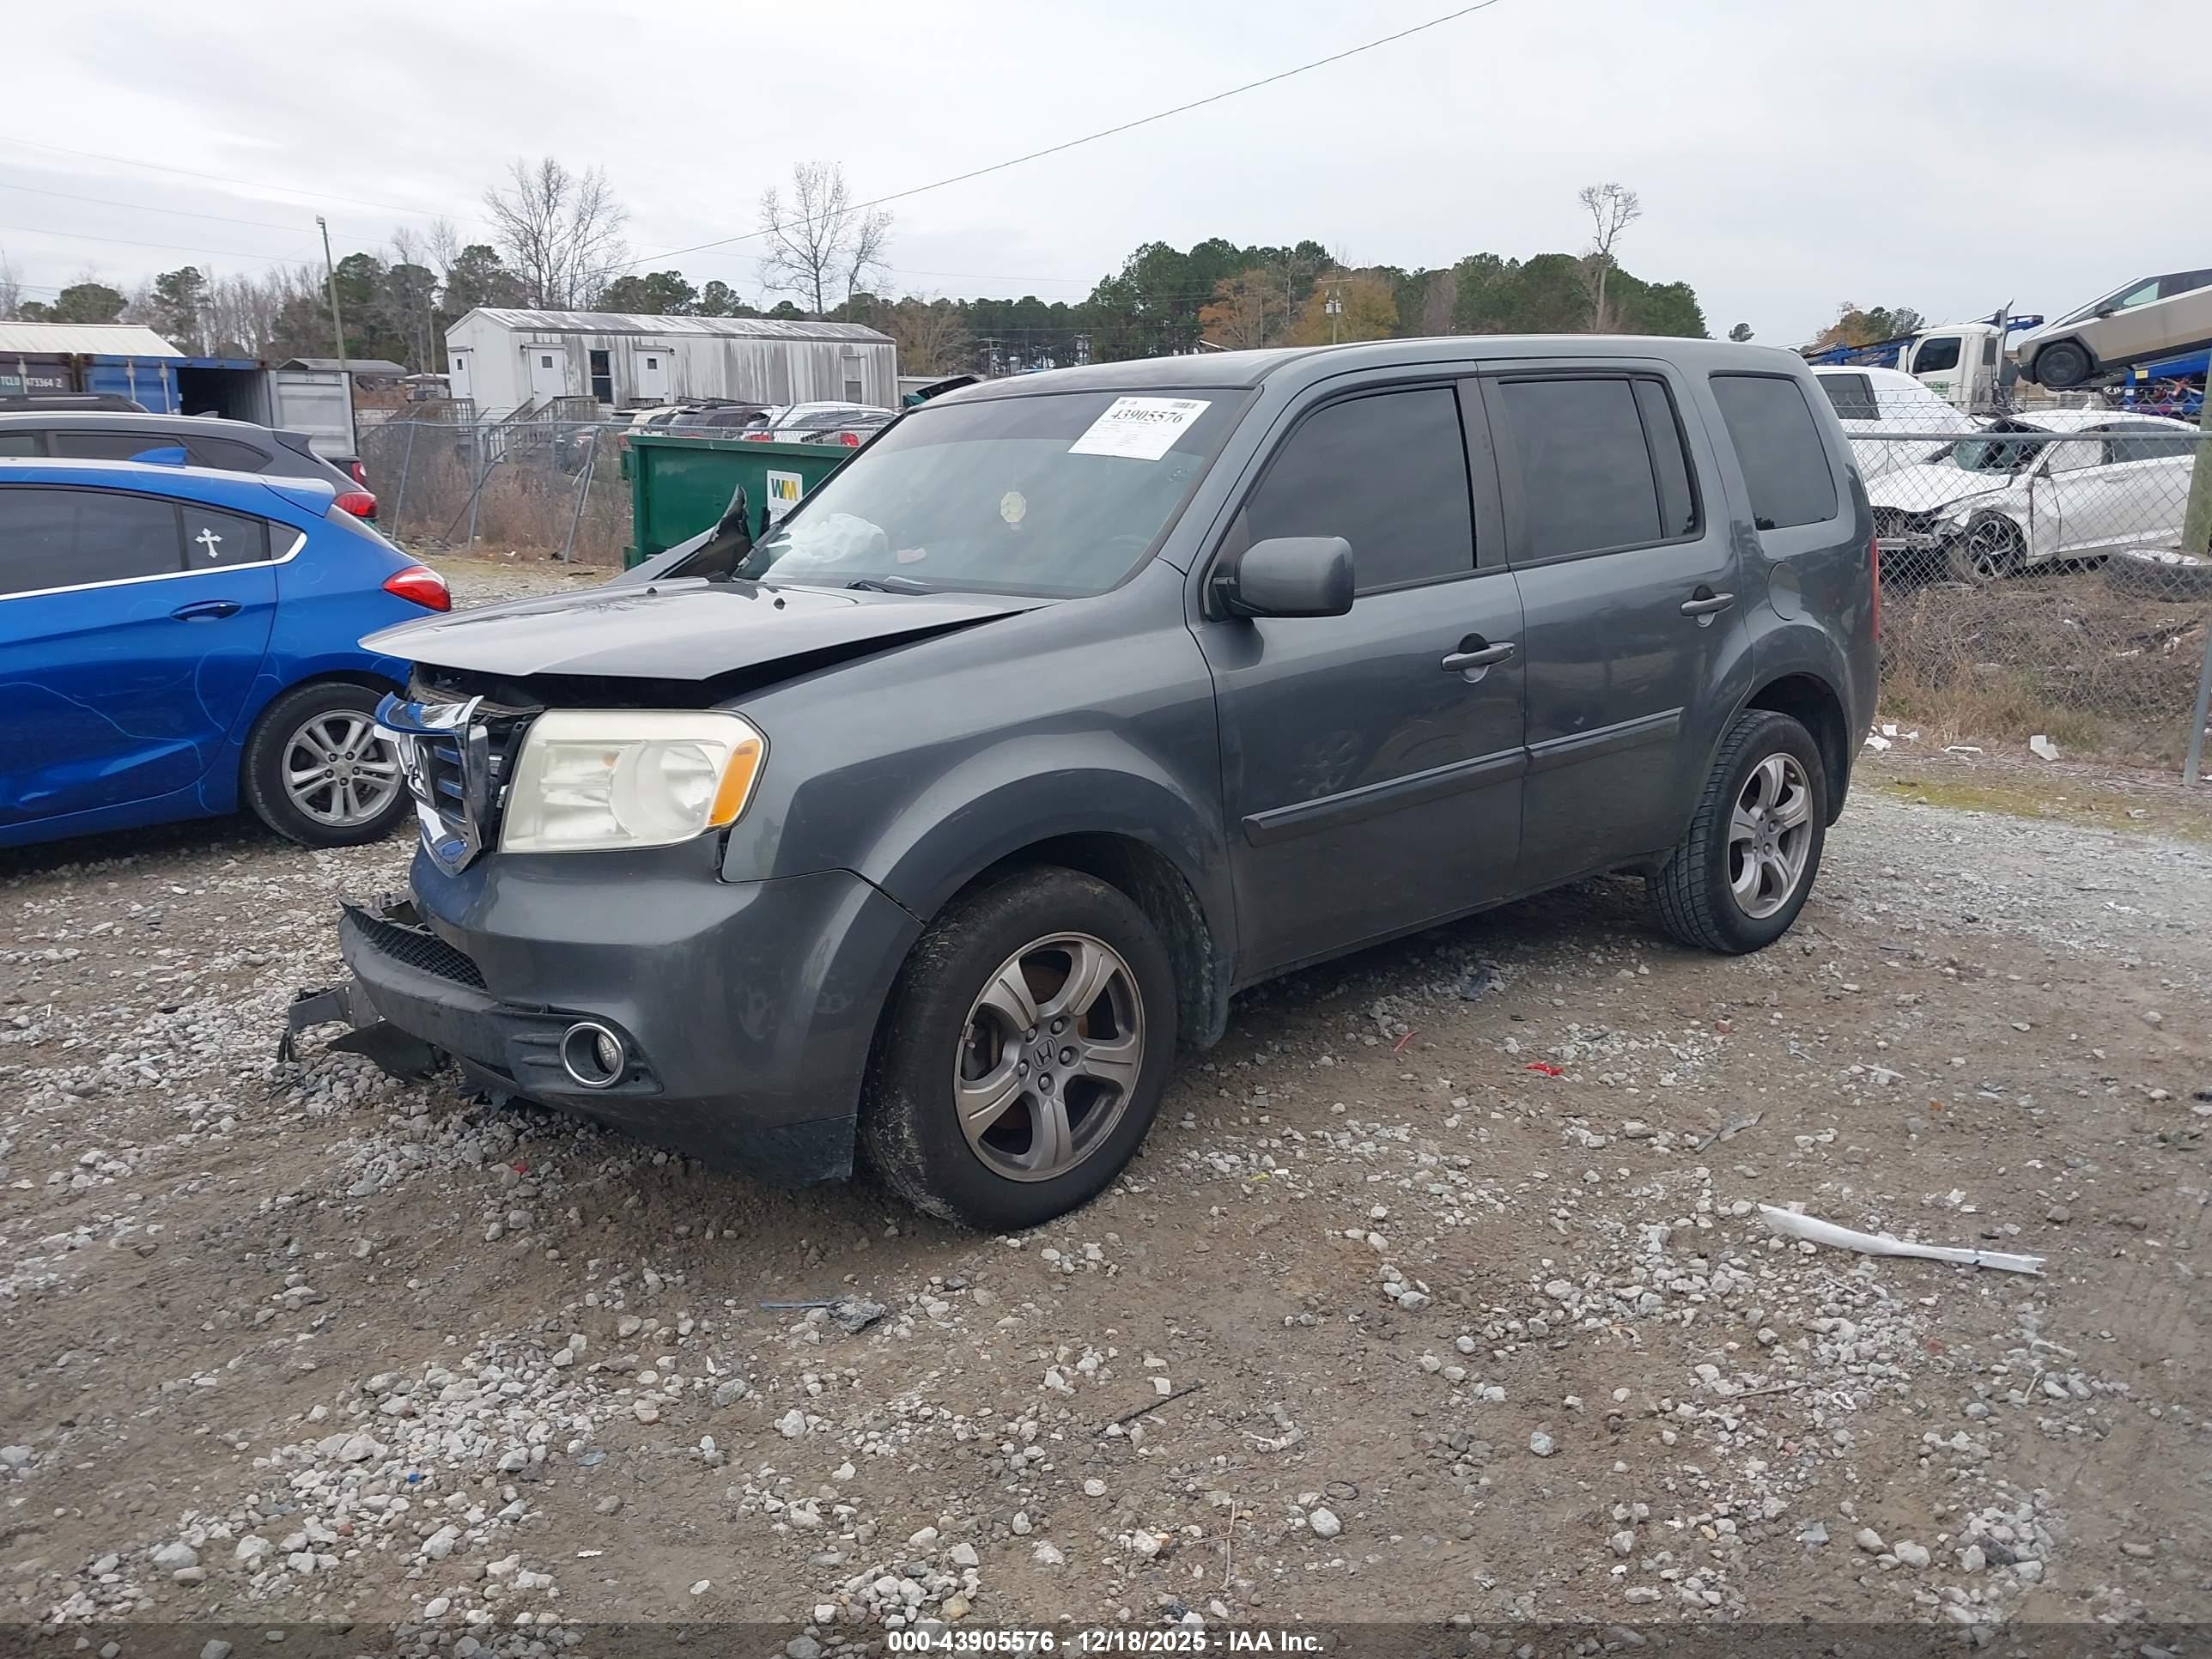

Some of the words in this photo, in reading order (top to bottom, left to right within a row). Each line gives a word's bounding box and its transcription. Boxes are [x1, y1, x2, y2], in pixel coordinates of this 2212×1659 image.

[55, 378, 63, 388] 2
[1111, 409, 1186, 423] 43905576
[770, 477, 798, 501] WM
